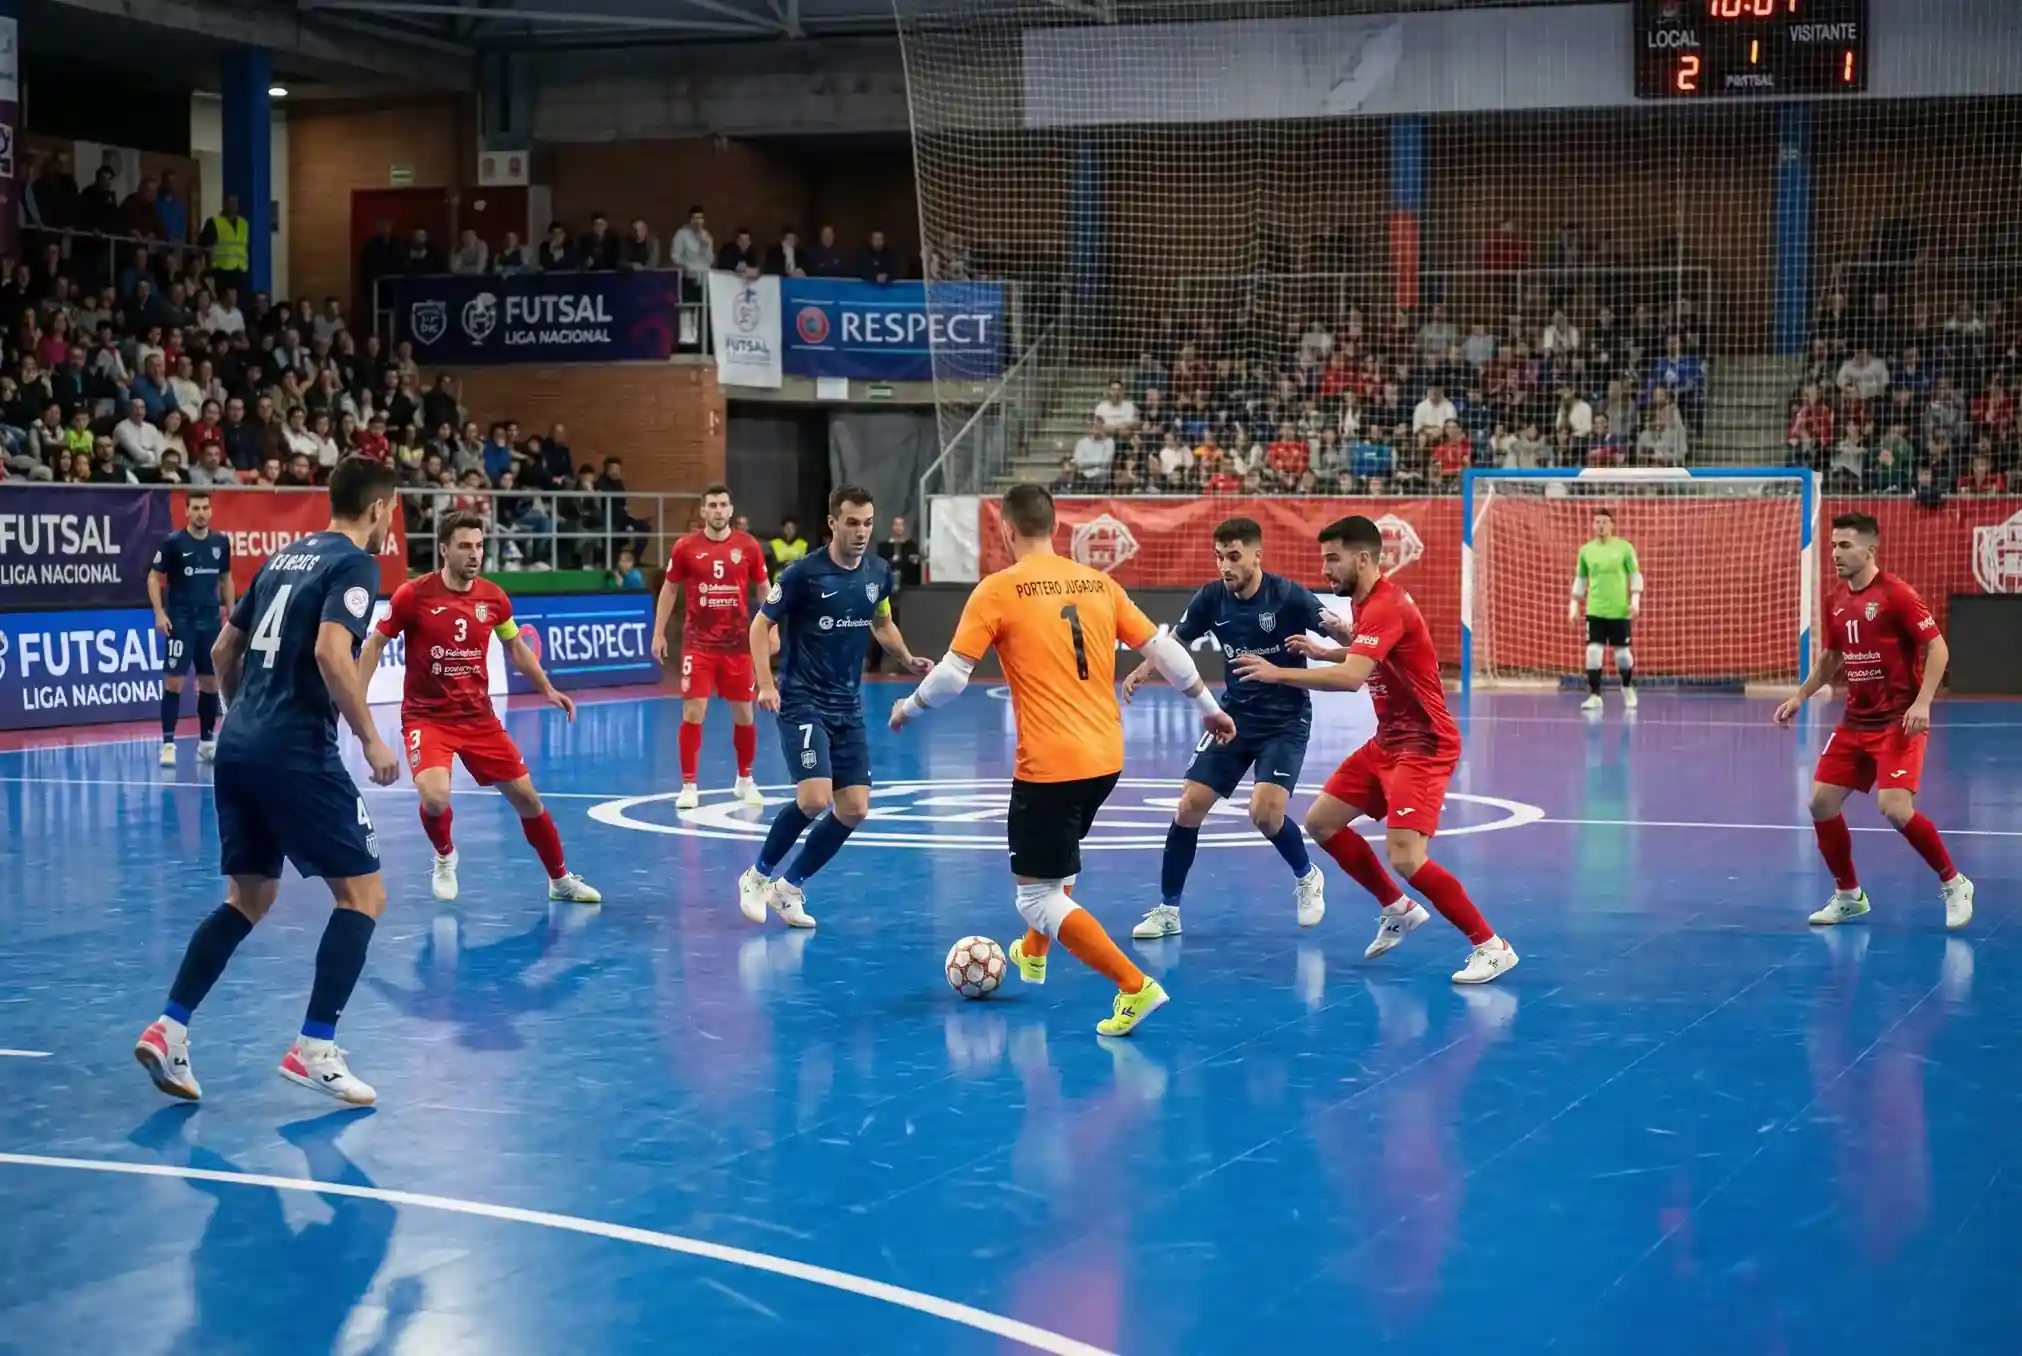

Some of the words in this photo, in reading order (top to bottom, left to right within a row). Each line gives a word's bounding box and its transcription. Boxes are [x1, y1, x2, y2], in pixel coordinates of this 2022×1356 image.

[1648, 30, 1699, 48] LOCAL
[1790, 22, 1856, 42] VISITANTE
[1751, 40, 1759, 63] 1
[1678, 56, 1699, 90] 2
[1844, 51, 1853, 81] 1
[506, 294, 613, 324] FUTSAL
[505, 330, 536, 344] LIGA
[539, 328, 611, 344] NACIONAL
[841, 312, 993, 343] RESPECT
[0, 513, 121, 555] FUTSAL
[0, 564, 38, 585] LIGA
[41, 562, 122, 584] NACIONAL
[713, 560, 724, 579] 5
[1016, 580, 1062, 599] PORTERO
[1064, 579, 1105, 595] JUGADOR
[250, 584, 293, 669] 4
[454, 618, 467, 643] 3
[1845, 619, 1860, 644] 11
[18, 628, 164, 678] FUTSAL
[168, 639, 183, 657] 10
[549, 622, 646, 662] RESPECT
[1060, 603, 1089, 681] 1
[682, 655, 692, 675] 5
[23, 686, 67, 710] LIGA
[409, 729, 421, 750] 3
[799, 724, 813, 749] 7
[356, 796, 373, 830] 4
